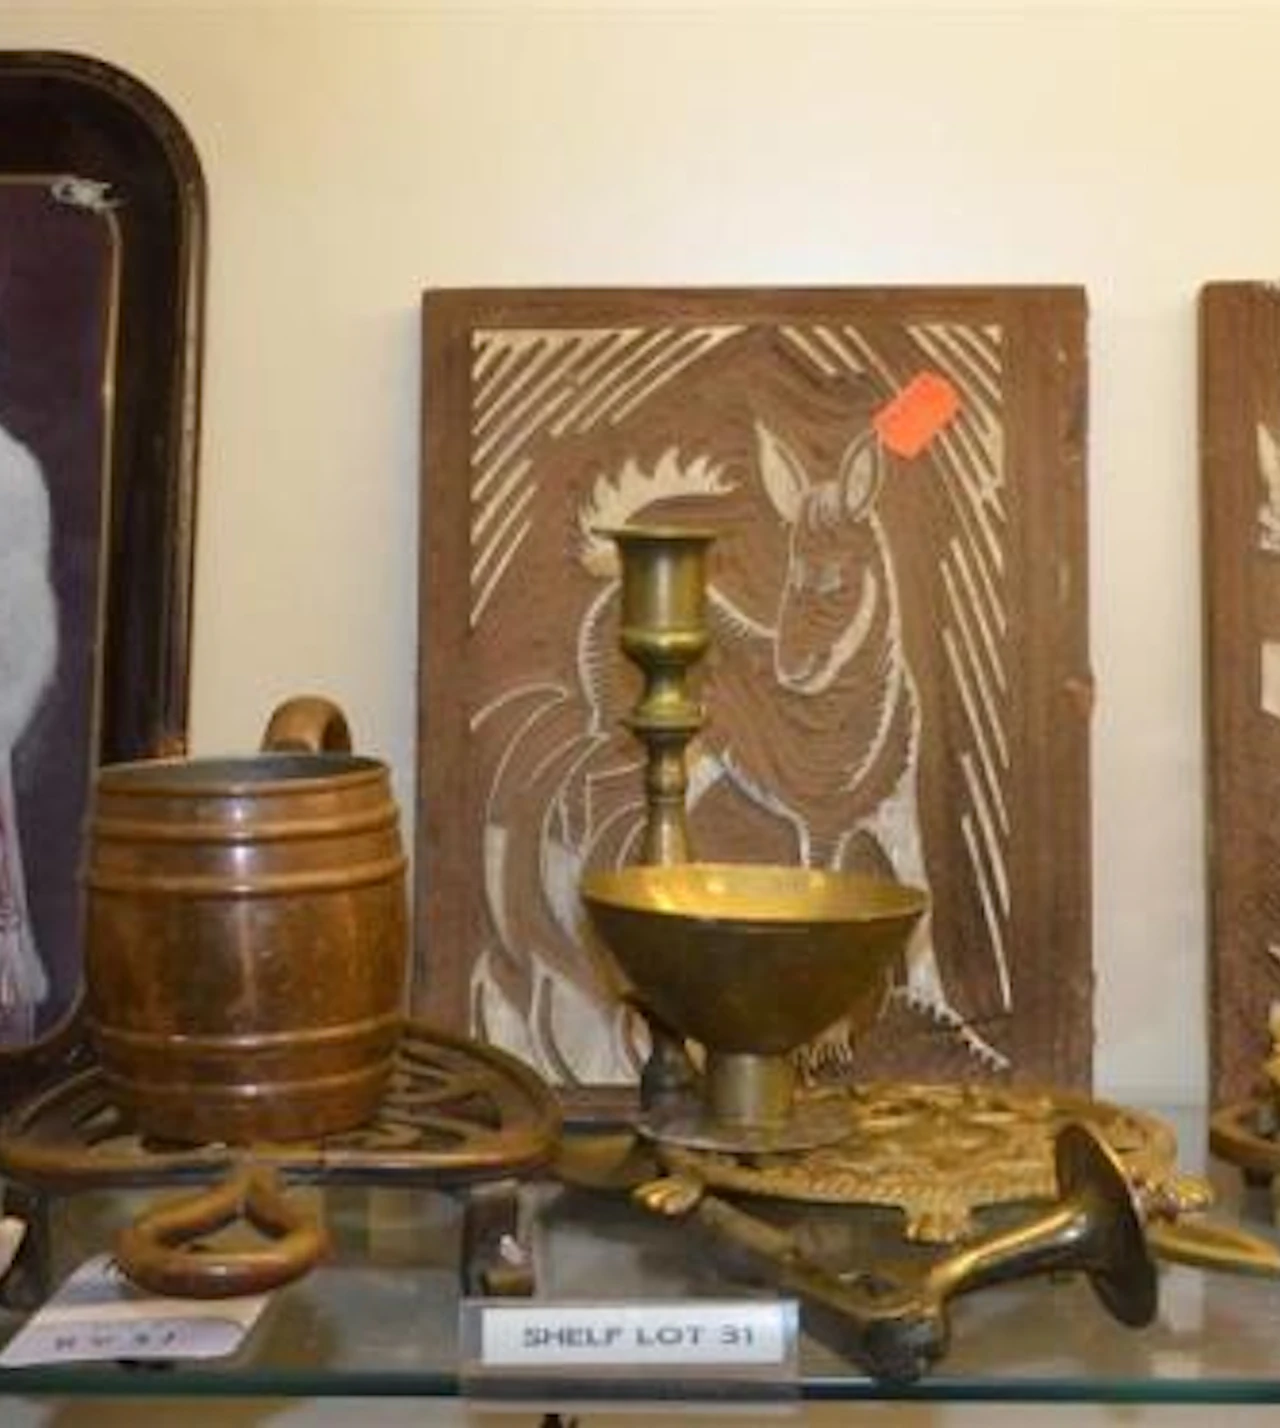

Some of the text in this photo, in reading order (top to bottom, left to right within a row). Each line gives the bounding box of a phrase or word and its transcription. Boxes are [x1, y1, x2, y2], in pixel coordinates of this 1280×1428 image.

[524, 1323, 754, 1349] SHELF LOT 31
